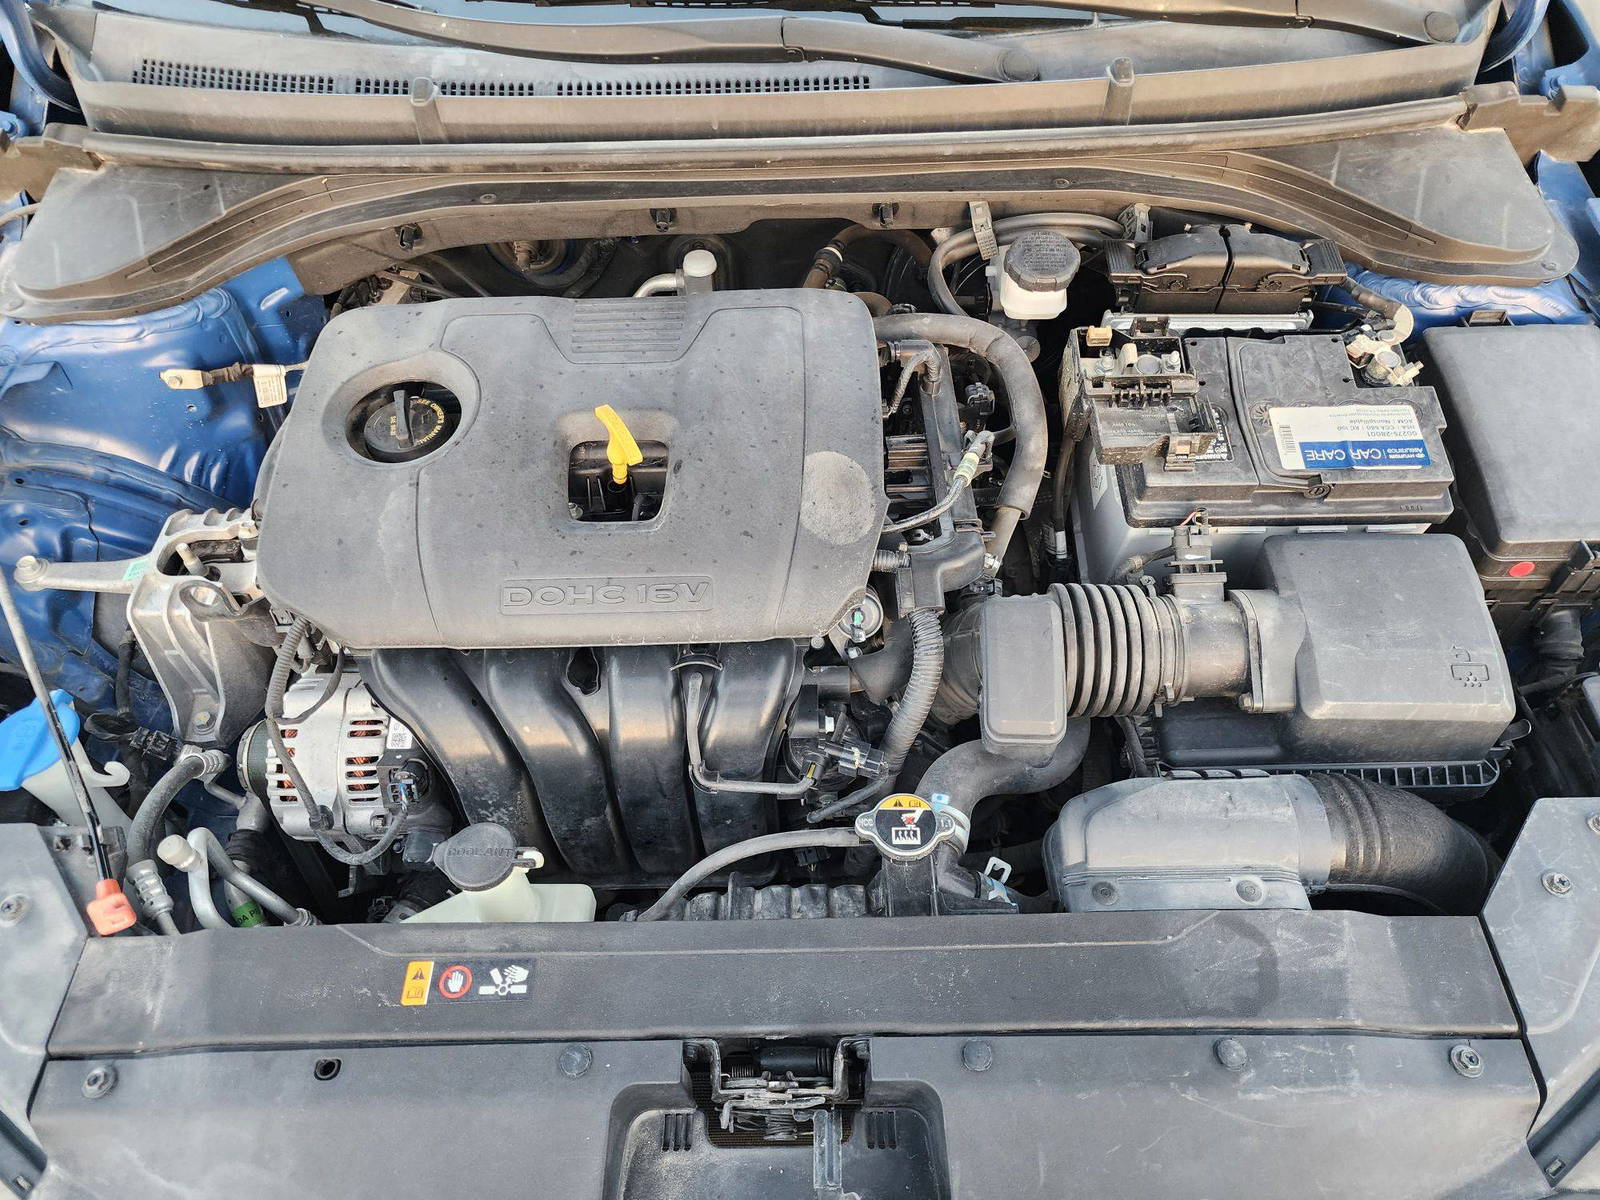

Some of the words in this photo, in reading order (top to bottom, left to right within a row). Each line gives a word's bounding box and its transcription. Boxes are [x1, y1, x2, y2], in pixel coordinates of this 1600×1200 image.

[1304, 449, 1346, 461] CARE
[1350, 448, 1382, 460] CAR
[504, 585, 626, 607] DOHC
[636, 582, 710, 604] 16V
[447, 847, 513, 859] COOLANT
